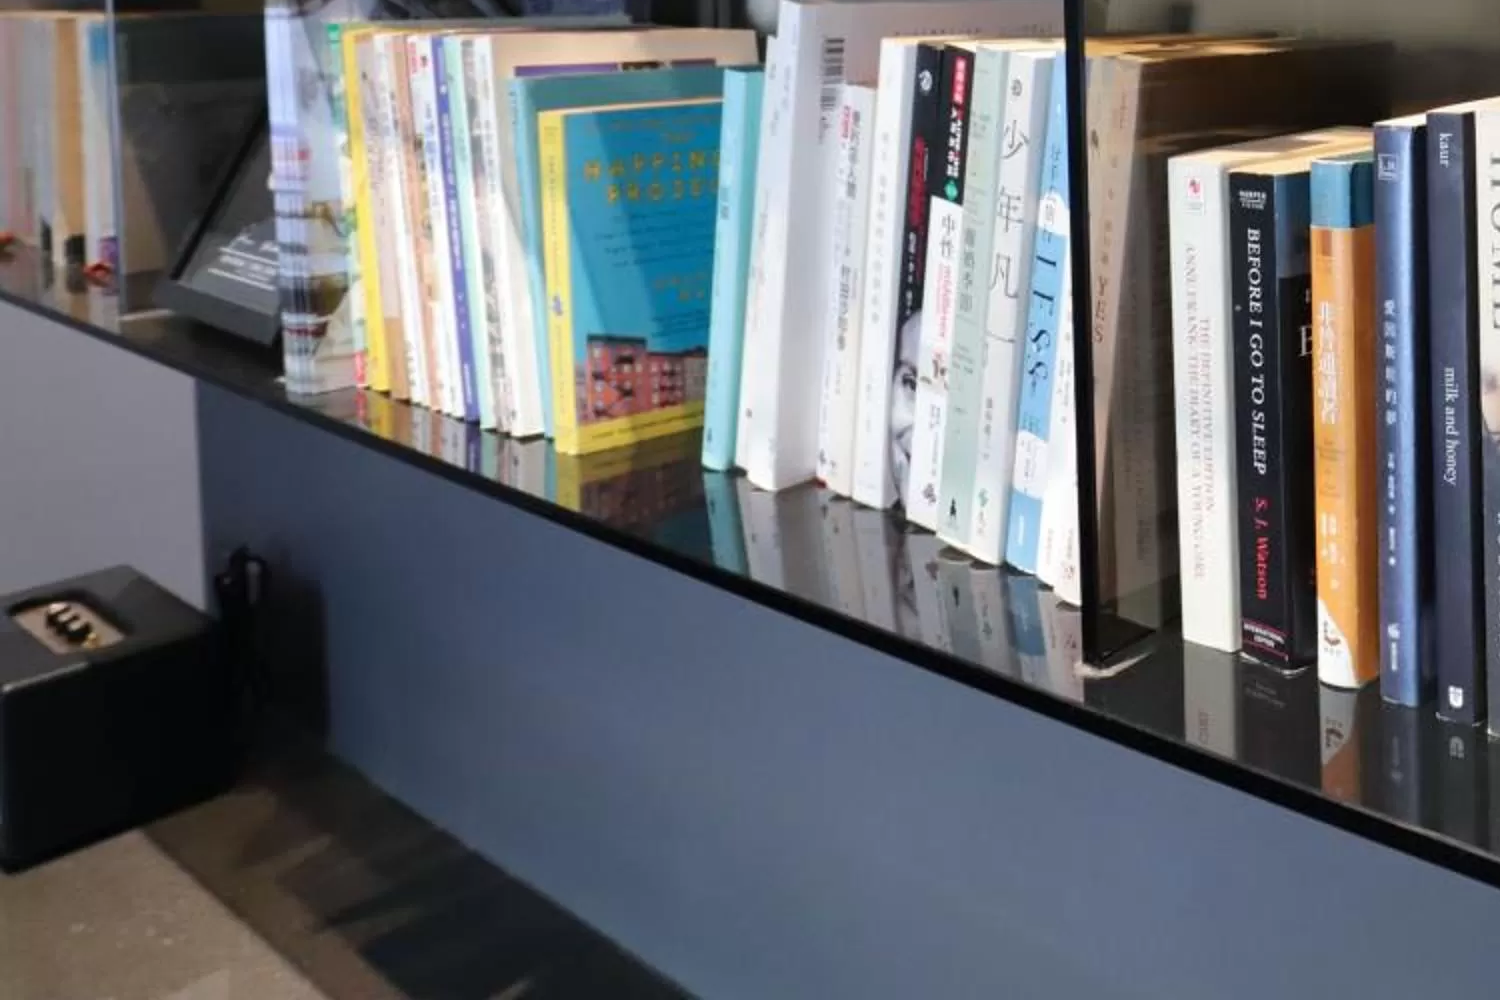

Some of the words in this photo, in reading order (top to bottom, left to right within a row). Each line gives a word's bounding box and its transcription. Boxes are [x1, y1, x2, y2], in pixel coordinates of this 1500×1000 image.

[1439, 132, 1453, 168] kaur
[1247, 227, 1264, 314] BEFORE
[1248, 320, 1264, 329] I
[1250, 333, 1264, 369] GO
[1251, 373, 1266, 406] TO
[1444, 366, 1459, 402] milk
[1445, 406, 1460, 436] and
[1251, 408, 1268, 476] SLEEP
[1443, 438, 1461, 486] honey
[1255, 536, 1270, 601] Watson
